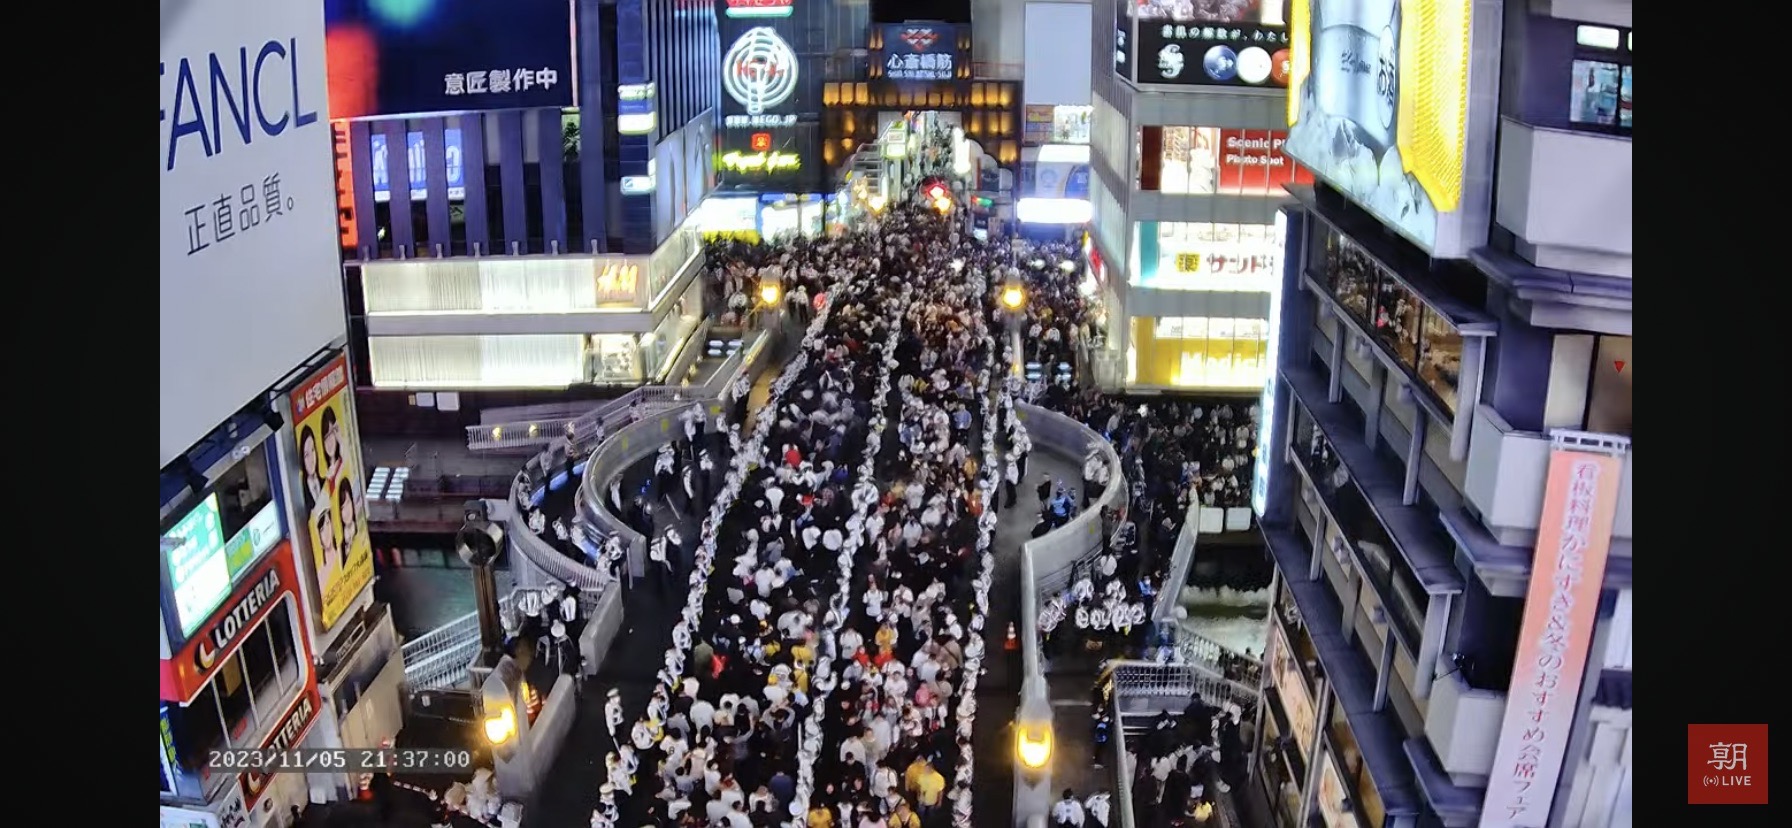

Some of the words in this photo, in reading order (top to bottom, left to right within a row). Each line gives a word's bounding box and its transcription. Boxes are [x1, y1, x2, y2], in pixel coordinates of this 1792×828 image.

[160, 38, 318, 171] ANCL
[444, 66, 558, 95] 意匠製作中
[184, 172, 294, 256] 正直品質。
[214, 568, 280, 649] LOTTERIA
